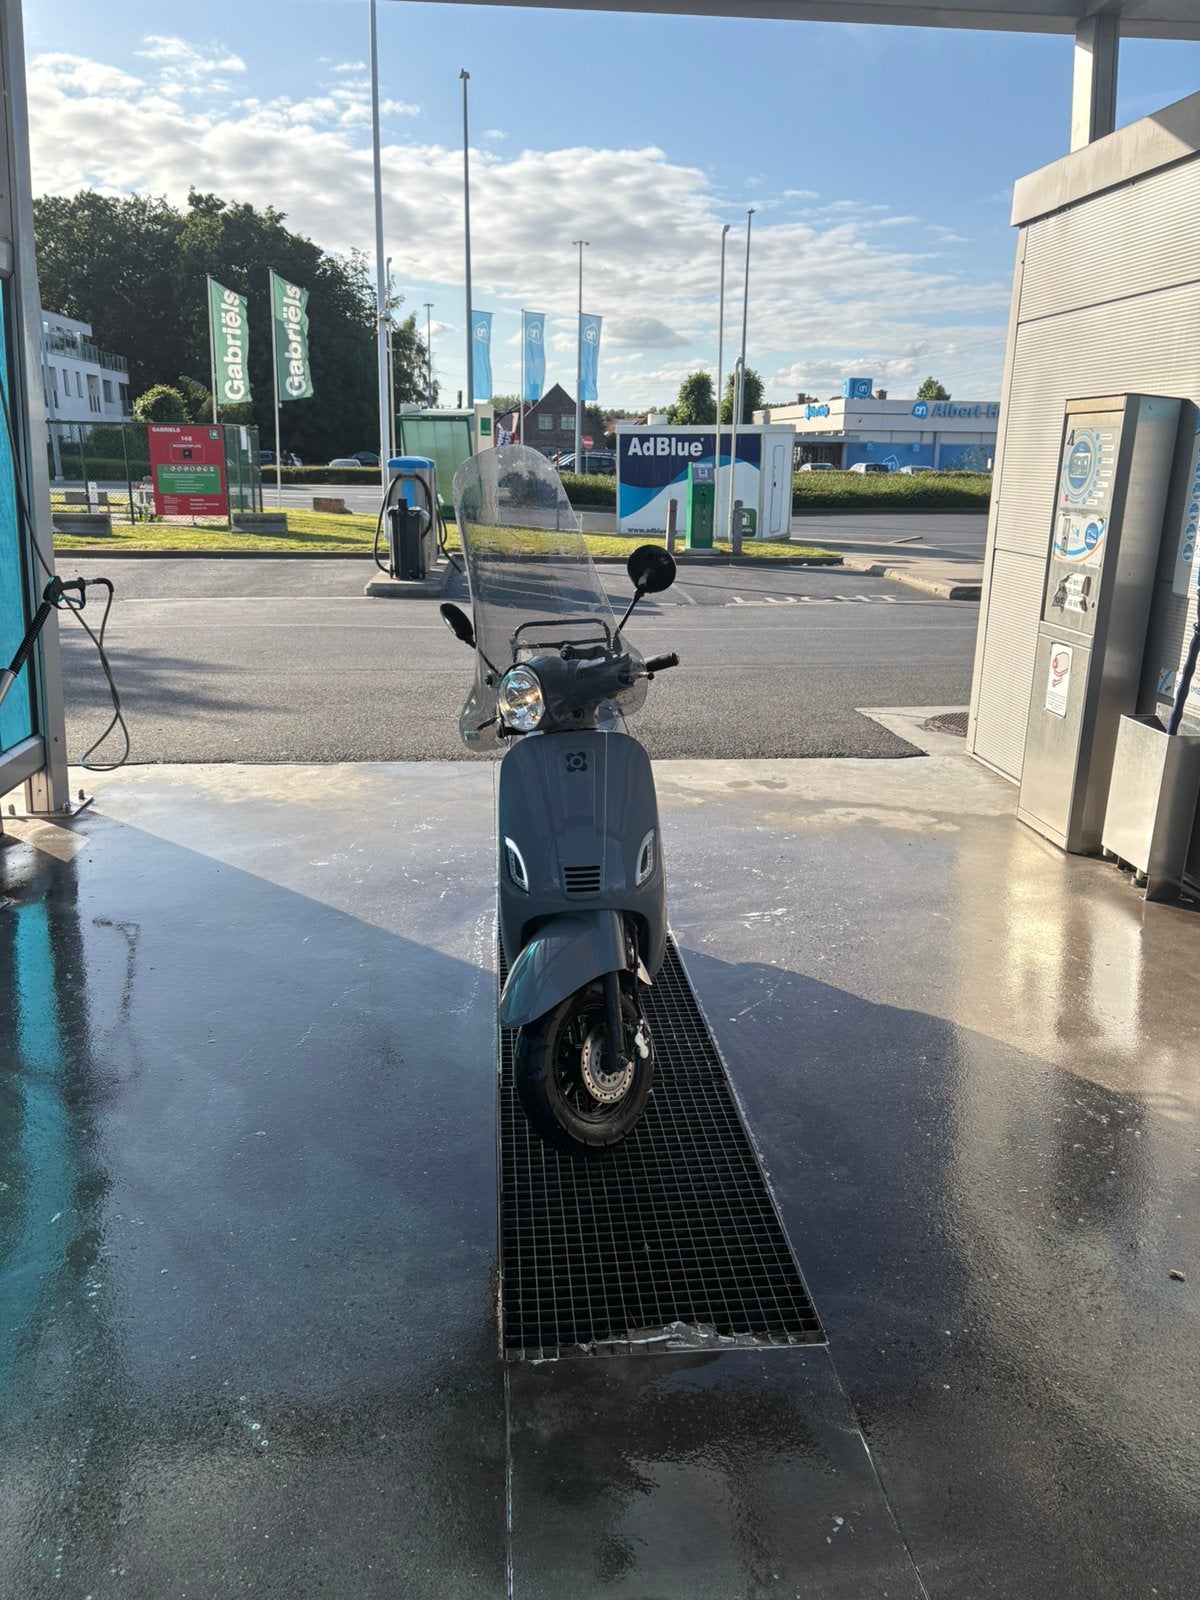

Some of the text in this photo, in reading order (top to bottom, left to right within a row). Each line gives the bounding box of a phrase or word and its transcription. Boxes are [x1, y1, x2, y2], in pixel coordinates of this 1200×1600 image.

[221, 290, 245, 400] Gabriëls
[283, 285, 307, 397] Gabriëls
[931, 402, 981, 418] Albert
[986, 403, 999, 418] H
